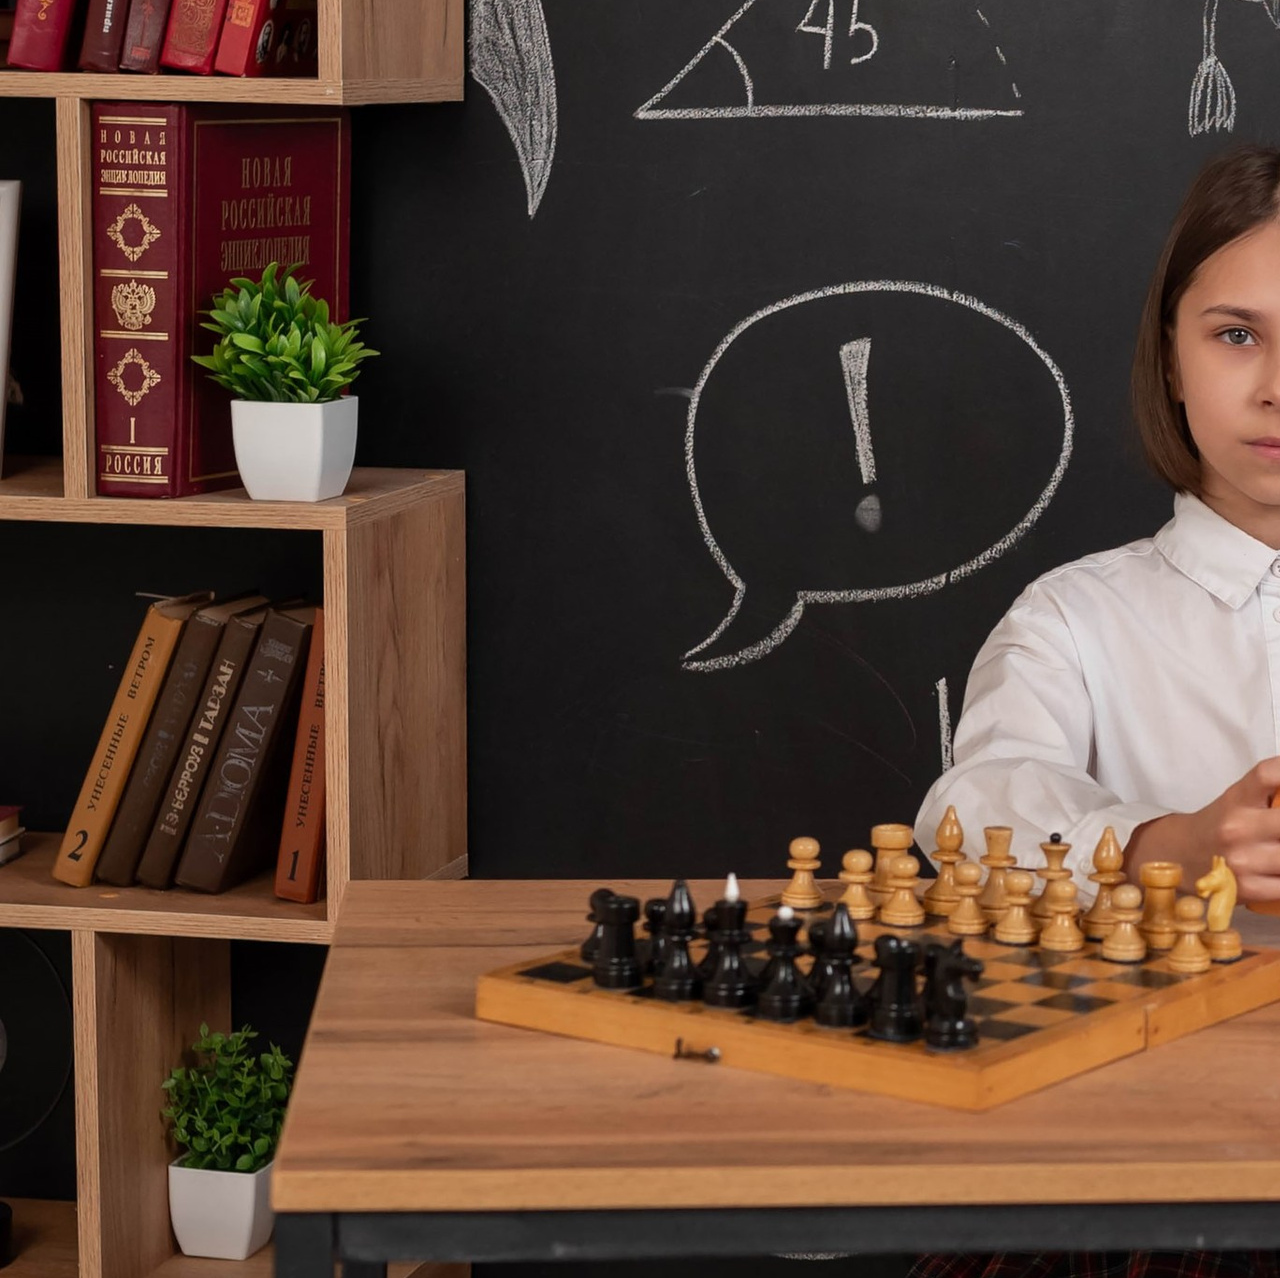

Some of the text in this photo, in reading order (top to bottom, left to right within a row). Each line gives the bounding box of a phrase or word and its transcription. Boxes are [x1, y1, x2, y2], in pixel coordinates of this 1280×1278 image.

[100, 129, 166, 145] НОВАЯ
[100, 149, 167, 165] РОССИЙСКАЯ
[241, 156, 292, 189] НОВАЯ
[100, 169, 167, 186] ЭНЦИКЛОПЕДИЯ
[221, 194, 311, 231] РОССИЙСКАЯ
[220, 235, 311, 275] ЭНЦИКЛОПЕДИЯ
[106, 455, 162, 474] РОССИЯ
[87, 636, 156, 812] УНЕСЕННЫЕ ВЕТРОМ
[296, 723, 321, 828] УНЕСЕННЫЕ
[67, 829, 89, 862] 2
[287, 849, 300, 883] 1
